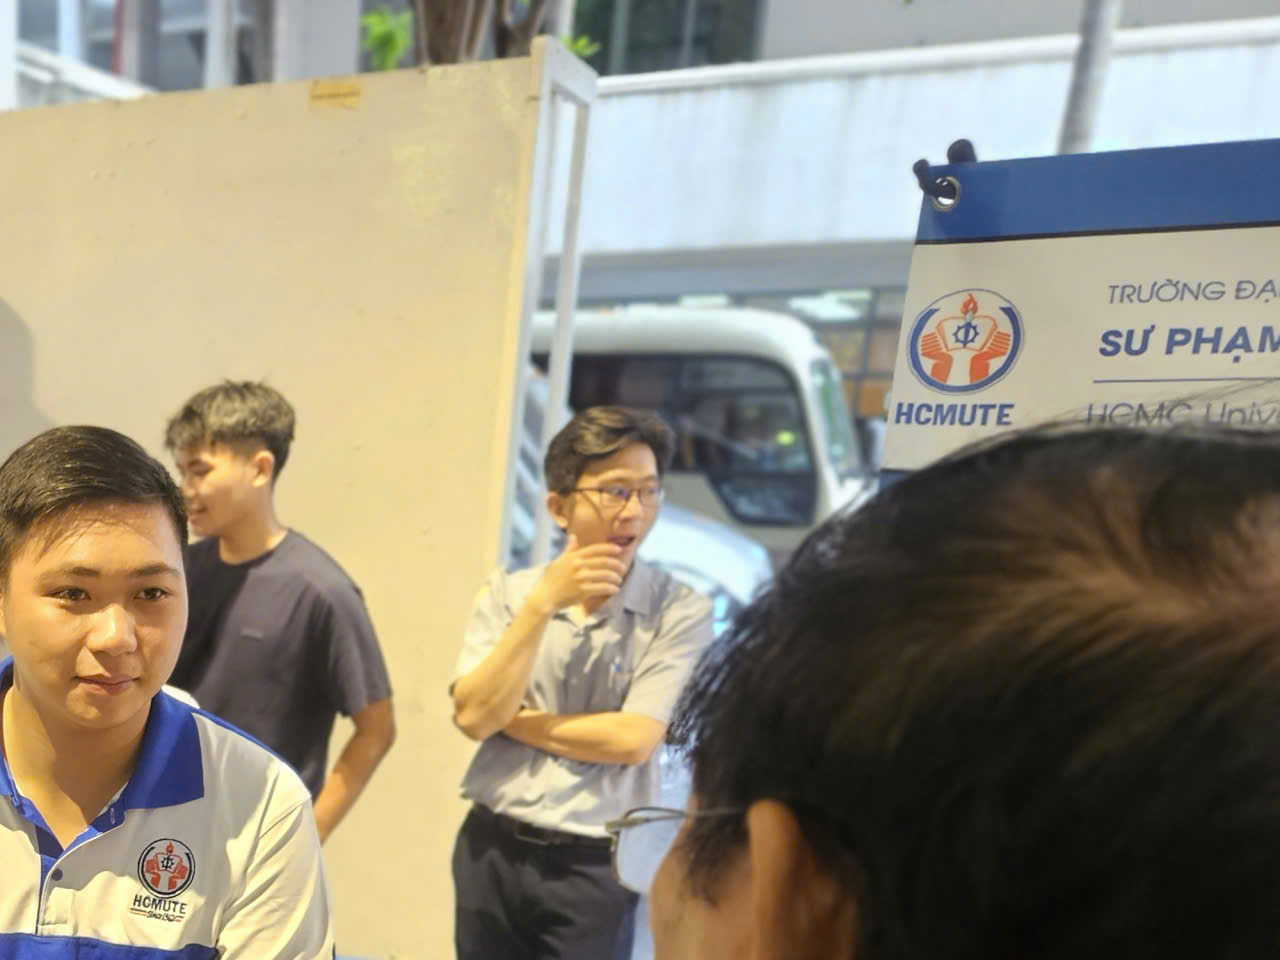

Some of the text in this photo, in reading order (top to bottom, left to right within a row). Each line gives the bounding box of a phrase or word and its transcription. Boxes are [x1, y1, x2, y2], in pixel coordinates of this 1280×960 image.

[1108, 278, 1280, 304] TRƯỜNG ĐẠ
[1098, 324, 1280, 363] SƯ PHẠM
[895, 401, 1015, 426] HCMUTE
[1205, 401, 1280, 427] Univ
[132, 894, 187, 915] HCMUTE
